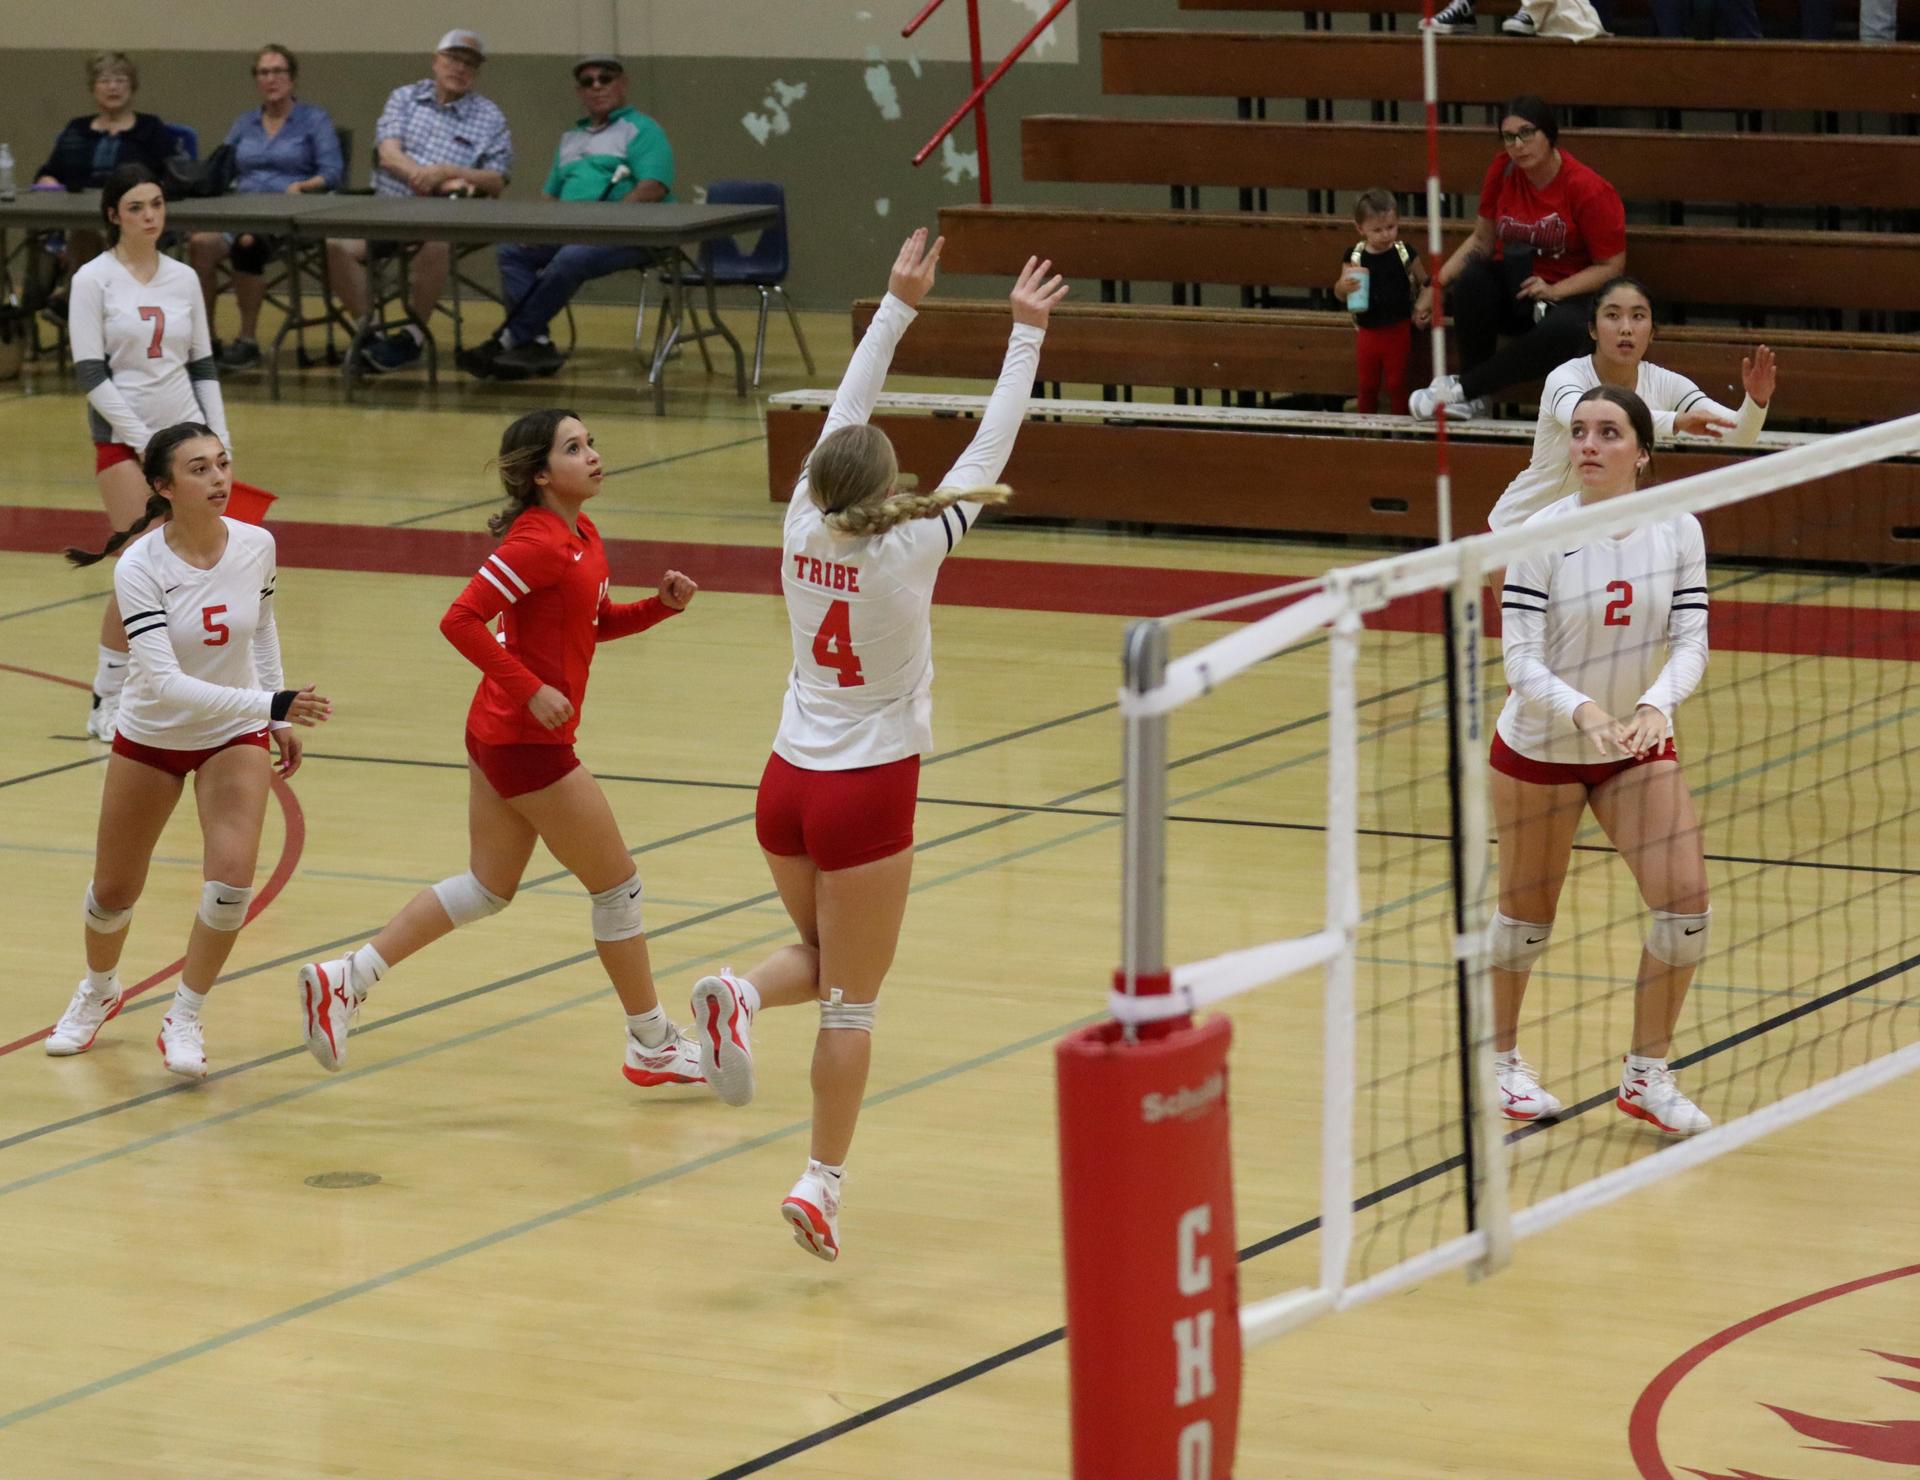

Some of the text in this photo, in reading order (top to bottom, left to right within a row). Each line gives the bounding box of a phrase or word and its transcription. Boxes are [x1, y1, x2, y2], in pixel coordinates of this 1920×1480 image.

[138, 306, 165, 359] 7
[794, 554, 860, 593] TRIBE
[202, 604, 229, 646] 5
[1604, 580, 1632, 626] 2
[812, 600, 865, 688] 4
